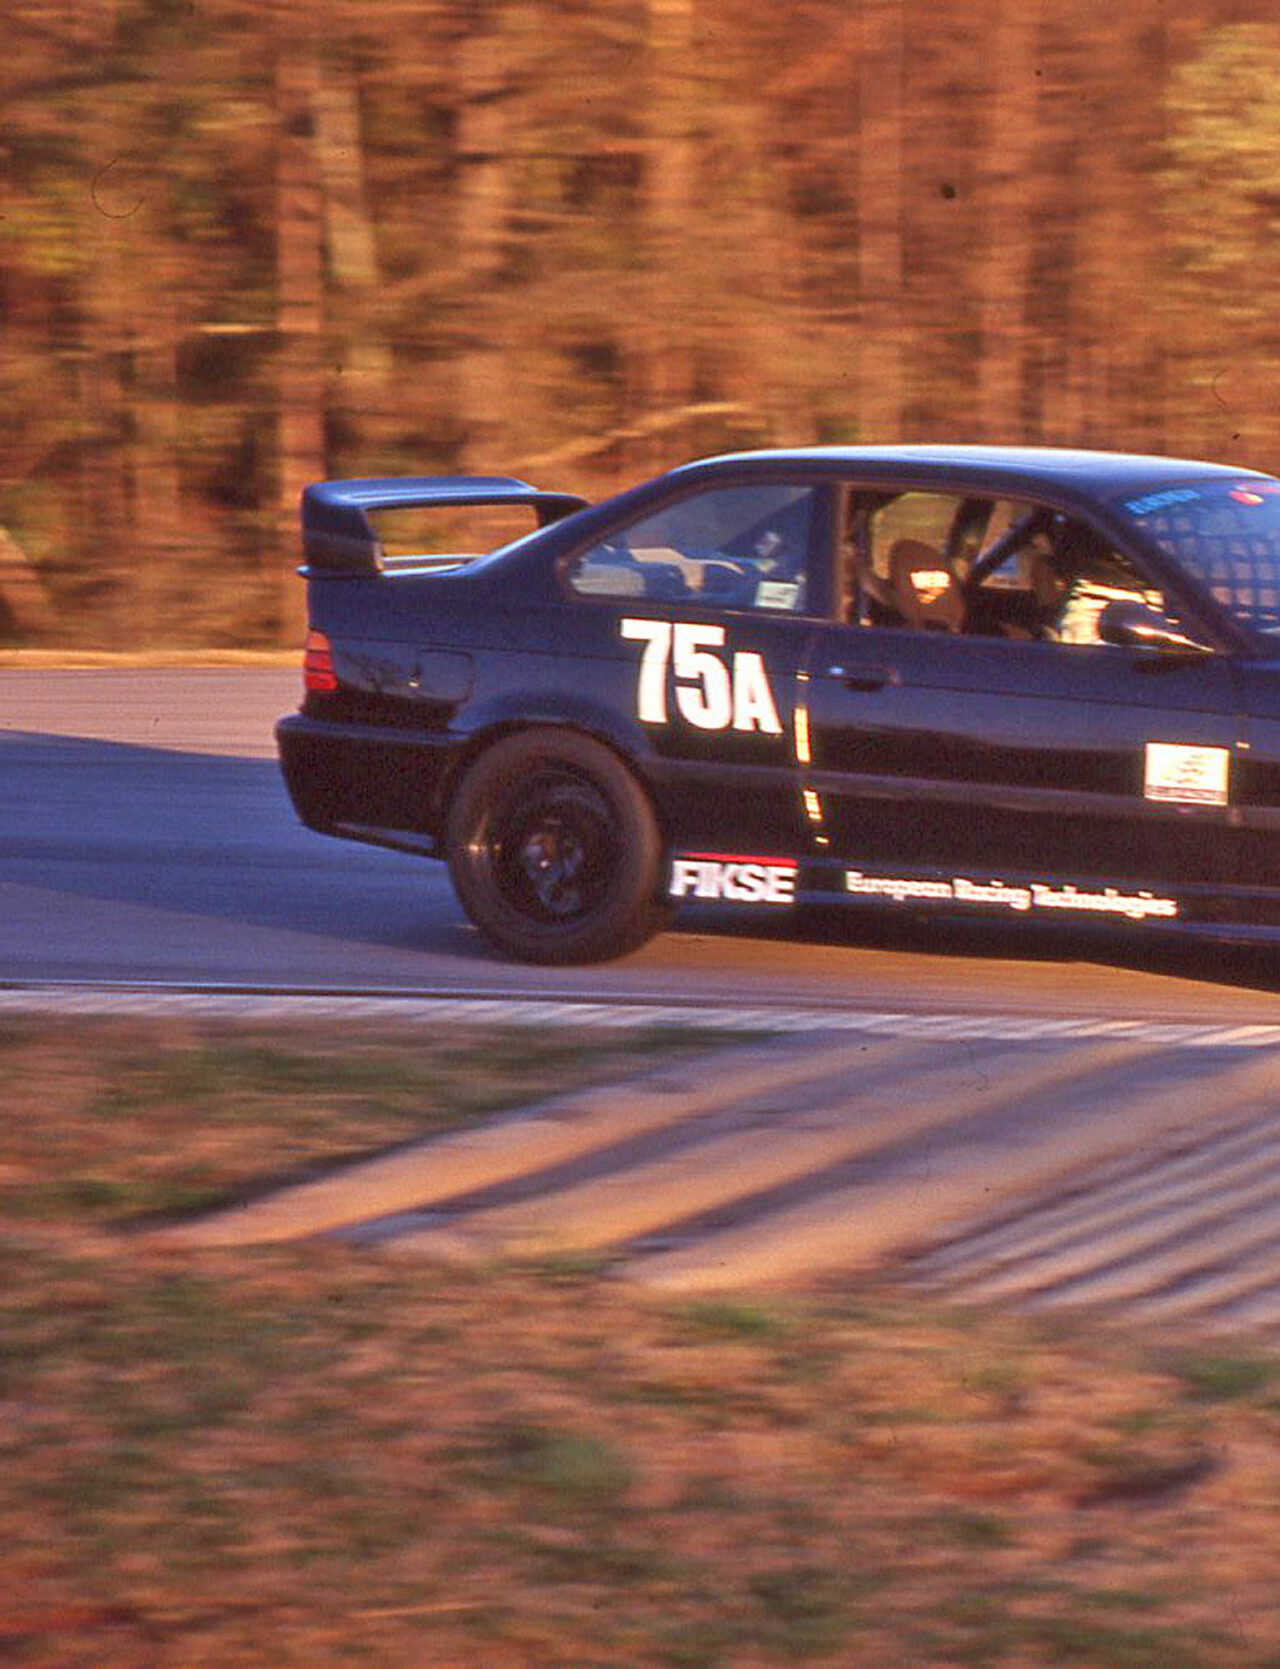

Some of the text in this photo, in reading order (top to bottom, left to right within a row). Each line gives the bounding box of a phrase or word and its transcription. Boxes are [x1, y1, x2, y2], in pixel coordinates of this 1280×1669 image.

[620, 618, 783, 734] 75A
[669, 860, 798, 903] FIKSE
[846, 871, 1178, 918] European Racing Technologies
